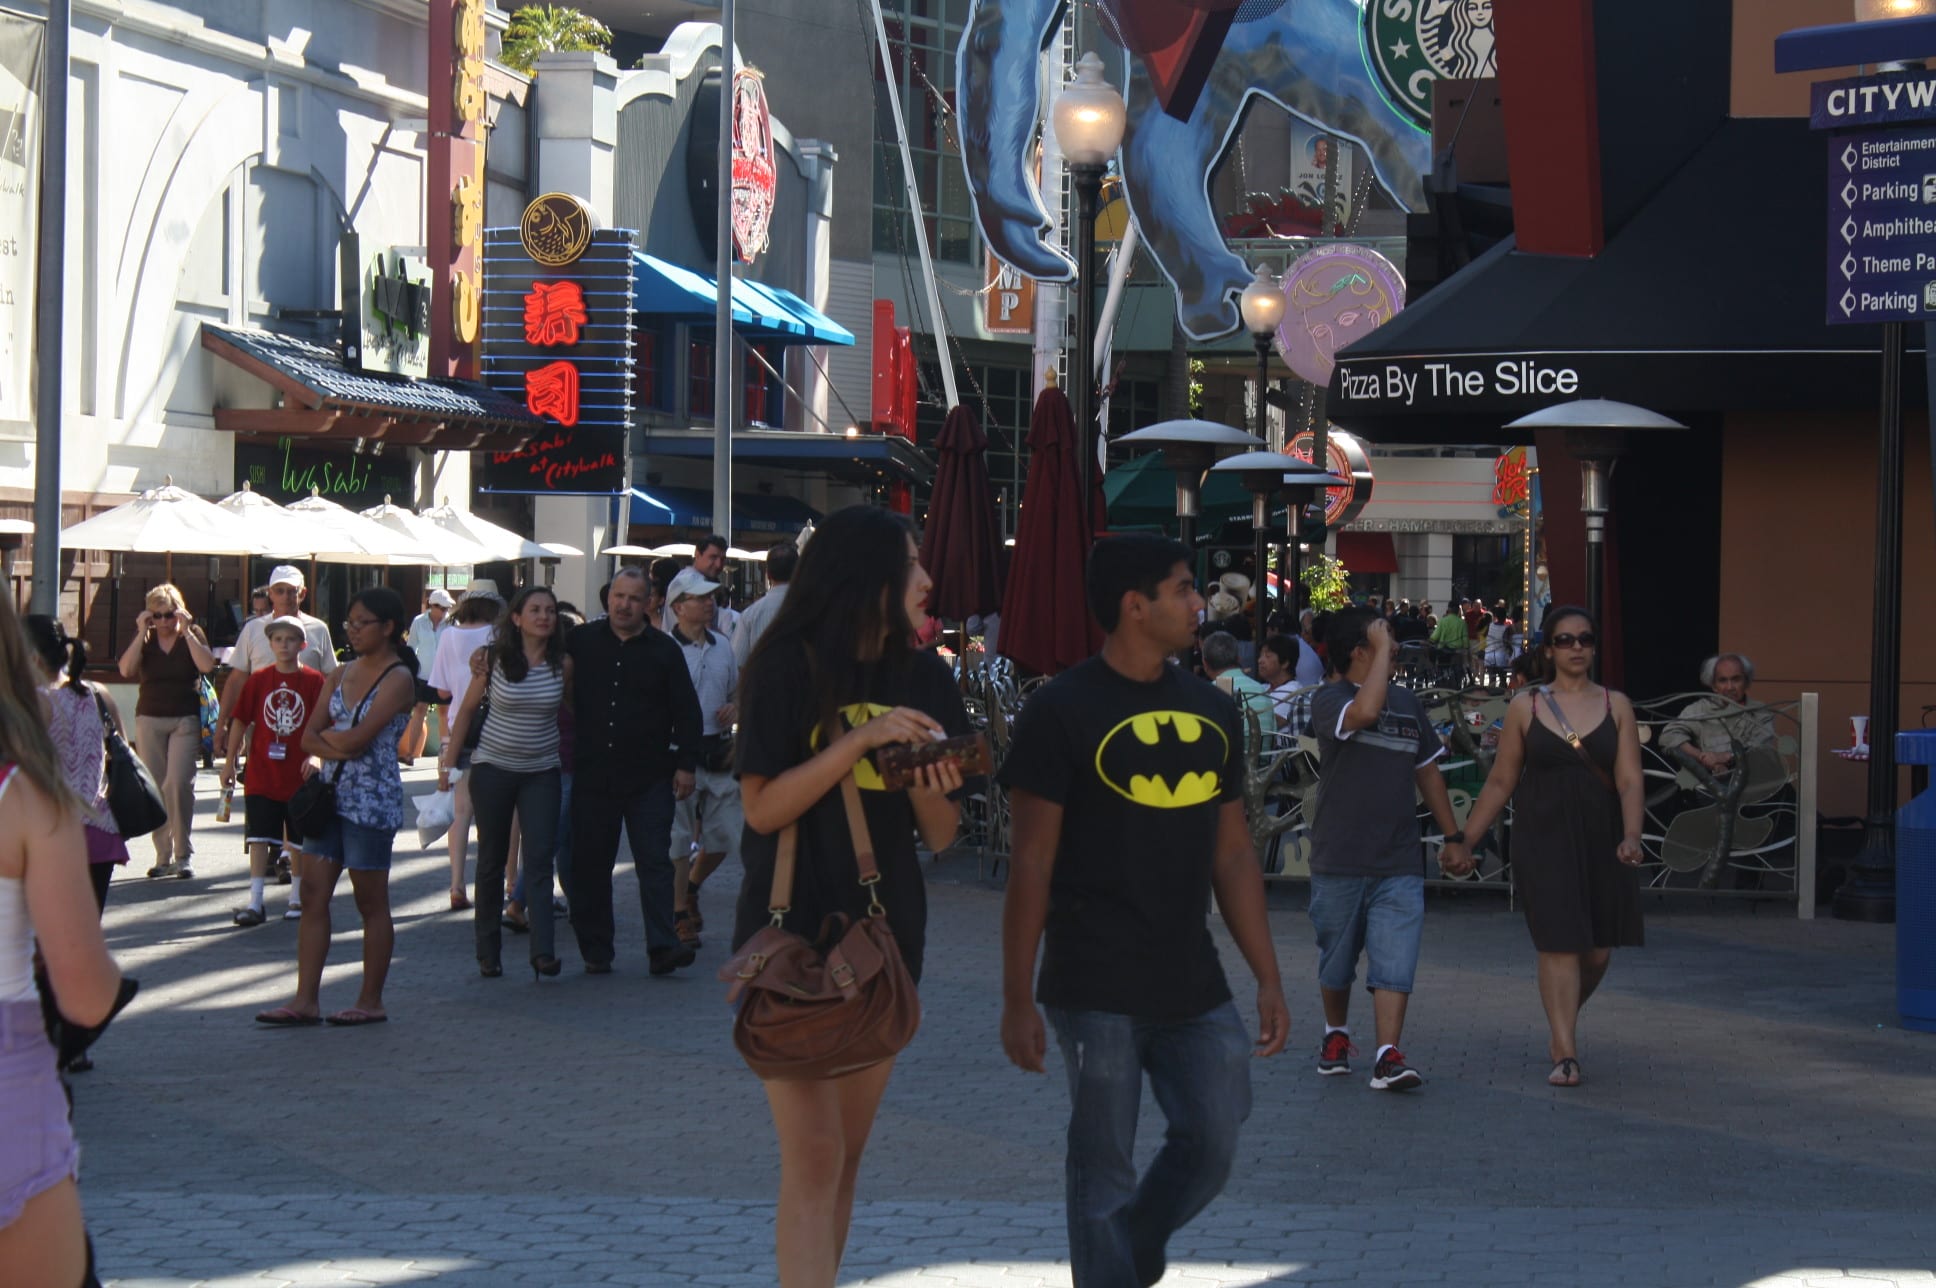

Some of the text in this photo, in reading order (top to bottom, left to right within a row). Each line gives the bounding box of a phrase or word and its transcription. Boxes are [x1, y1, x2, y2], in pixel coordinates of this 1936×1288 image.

[1827, 80, 1936, 116] CITYW
[1862, 139, 1936, 155] Entertainmen
[1862, 155, 1900, 170] District
[0, 173, 25, 197] walk
[1863, 182, 1918, 202] Parking
[1862, 256, 1911, 274] Theme
[1861, 291, 1917, 313] Parking
[1341, 361, 1578, 405] Pizza By The Slice
[282, 437, 372, 494] Wasabi
[529, 457, 548, 474] at
